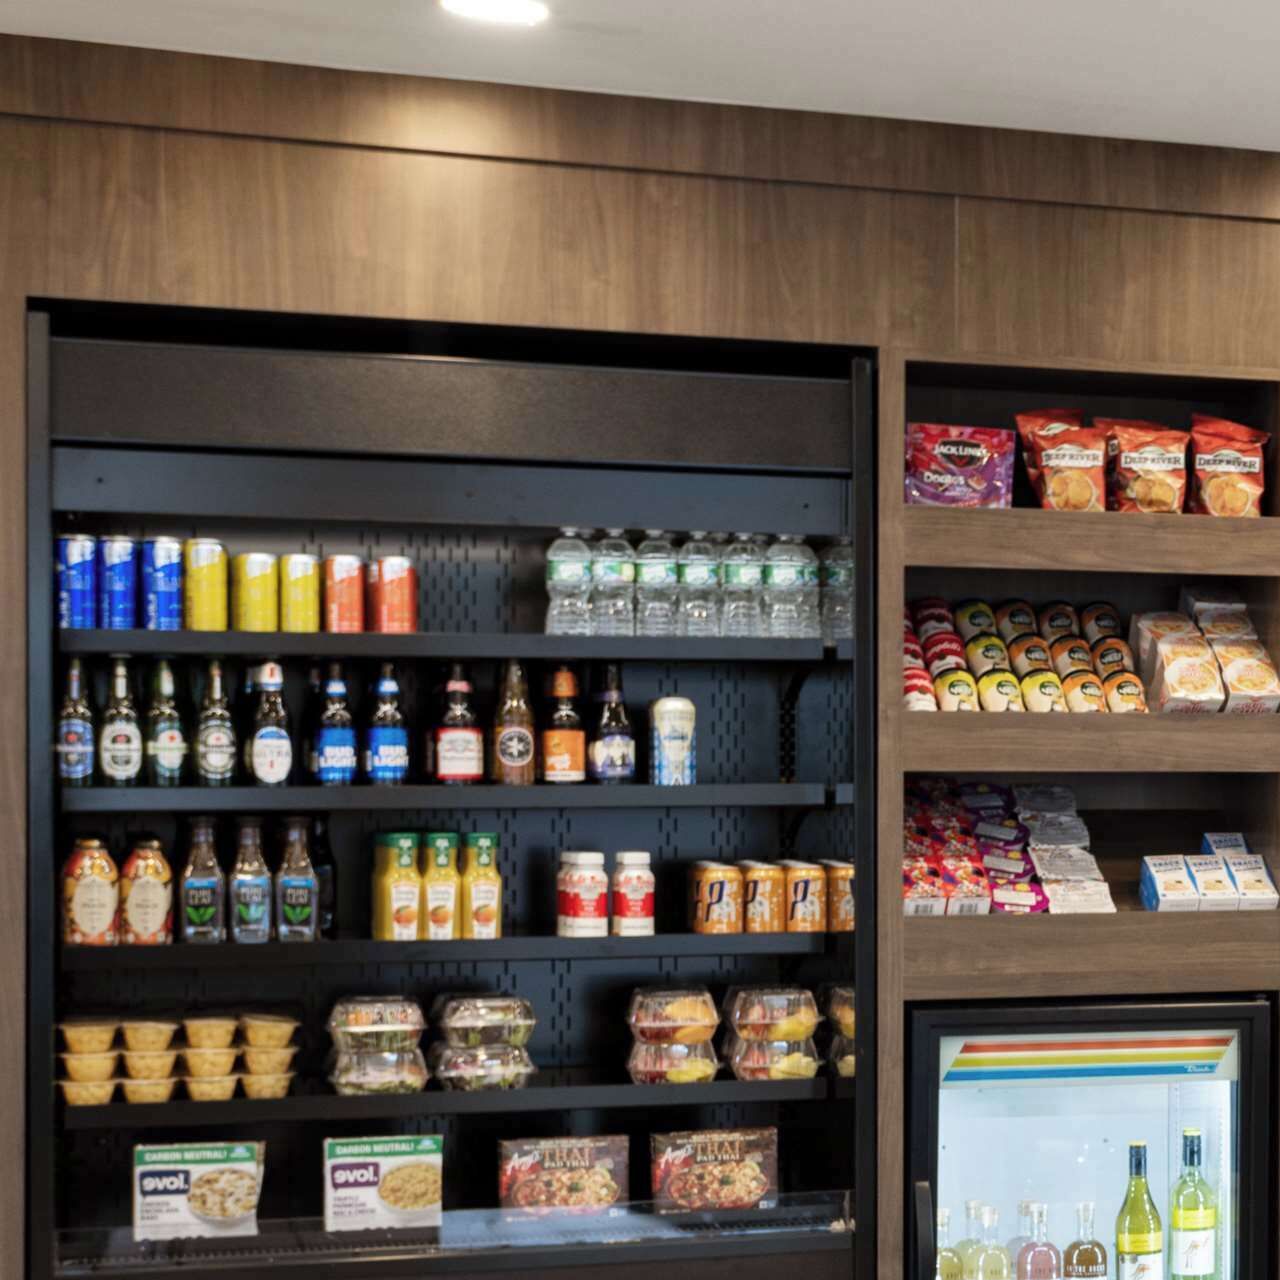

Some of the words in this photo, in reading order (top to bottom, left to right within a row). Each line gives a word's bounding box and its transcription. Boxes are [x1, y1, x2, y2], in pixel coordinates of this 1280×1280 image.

[1069, 453, 1099, 462] RIVER
[1124, 455, 1149, 465] DEEP
[1151, 456, 1181, 465] RIVER
[1198, 457, 1224, 467] DEEP
[1225, 459, 1257, 469] RIVER
[319, 756, 356, 768] LIGHT
[374, 756, 409, 768] LIGHT
[696, 1141, 742, 1155] THAI
[543, 1148, 592, 1161] THAI
